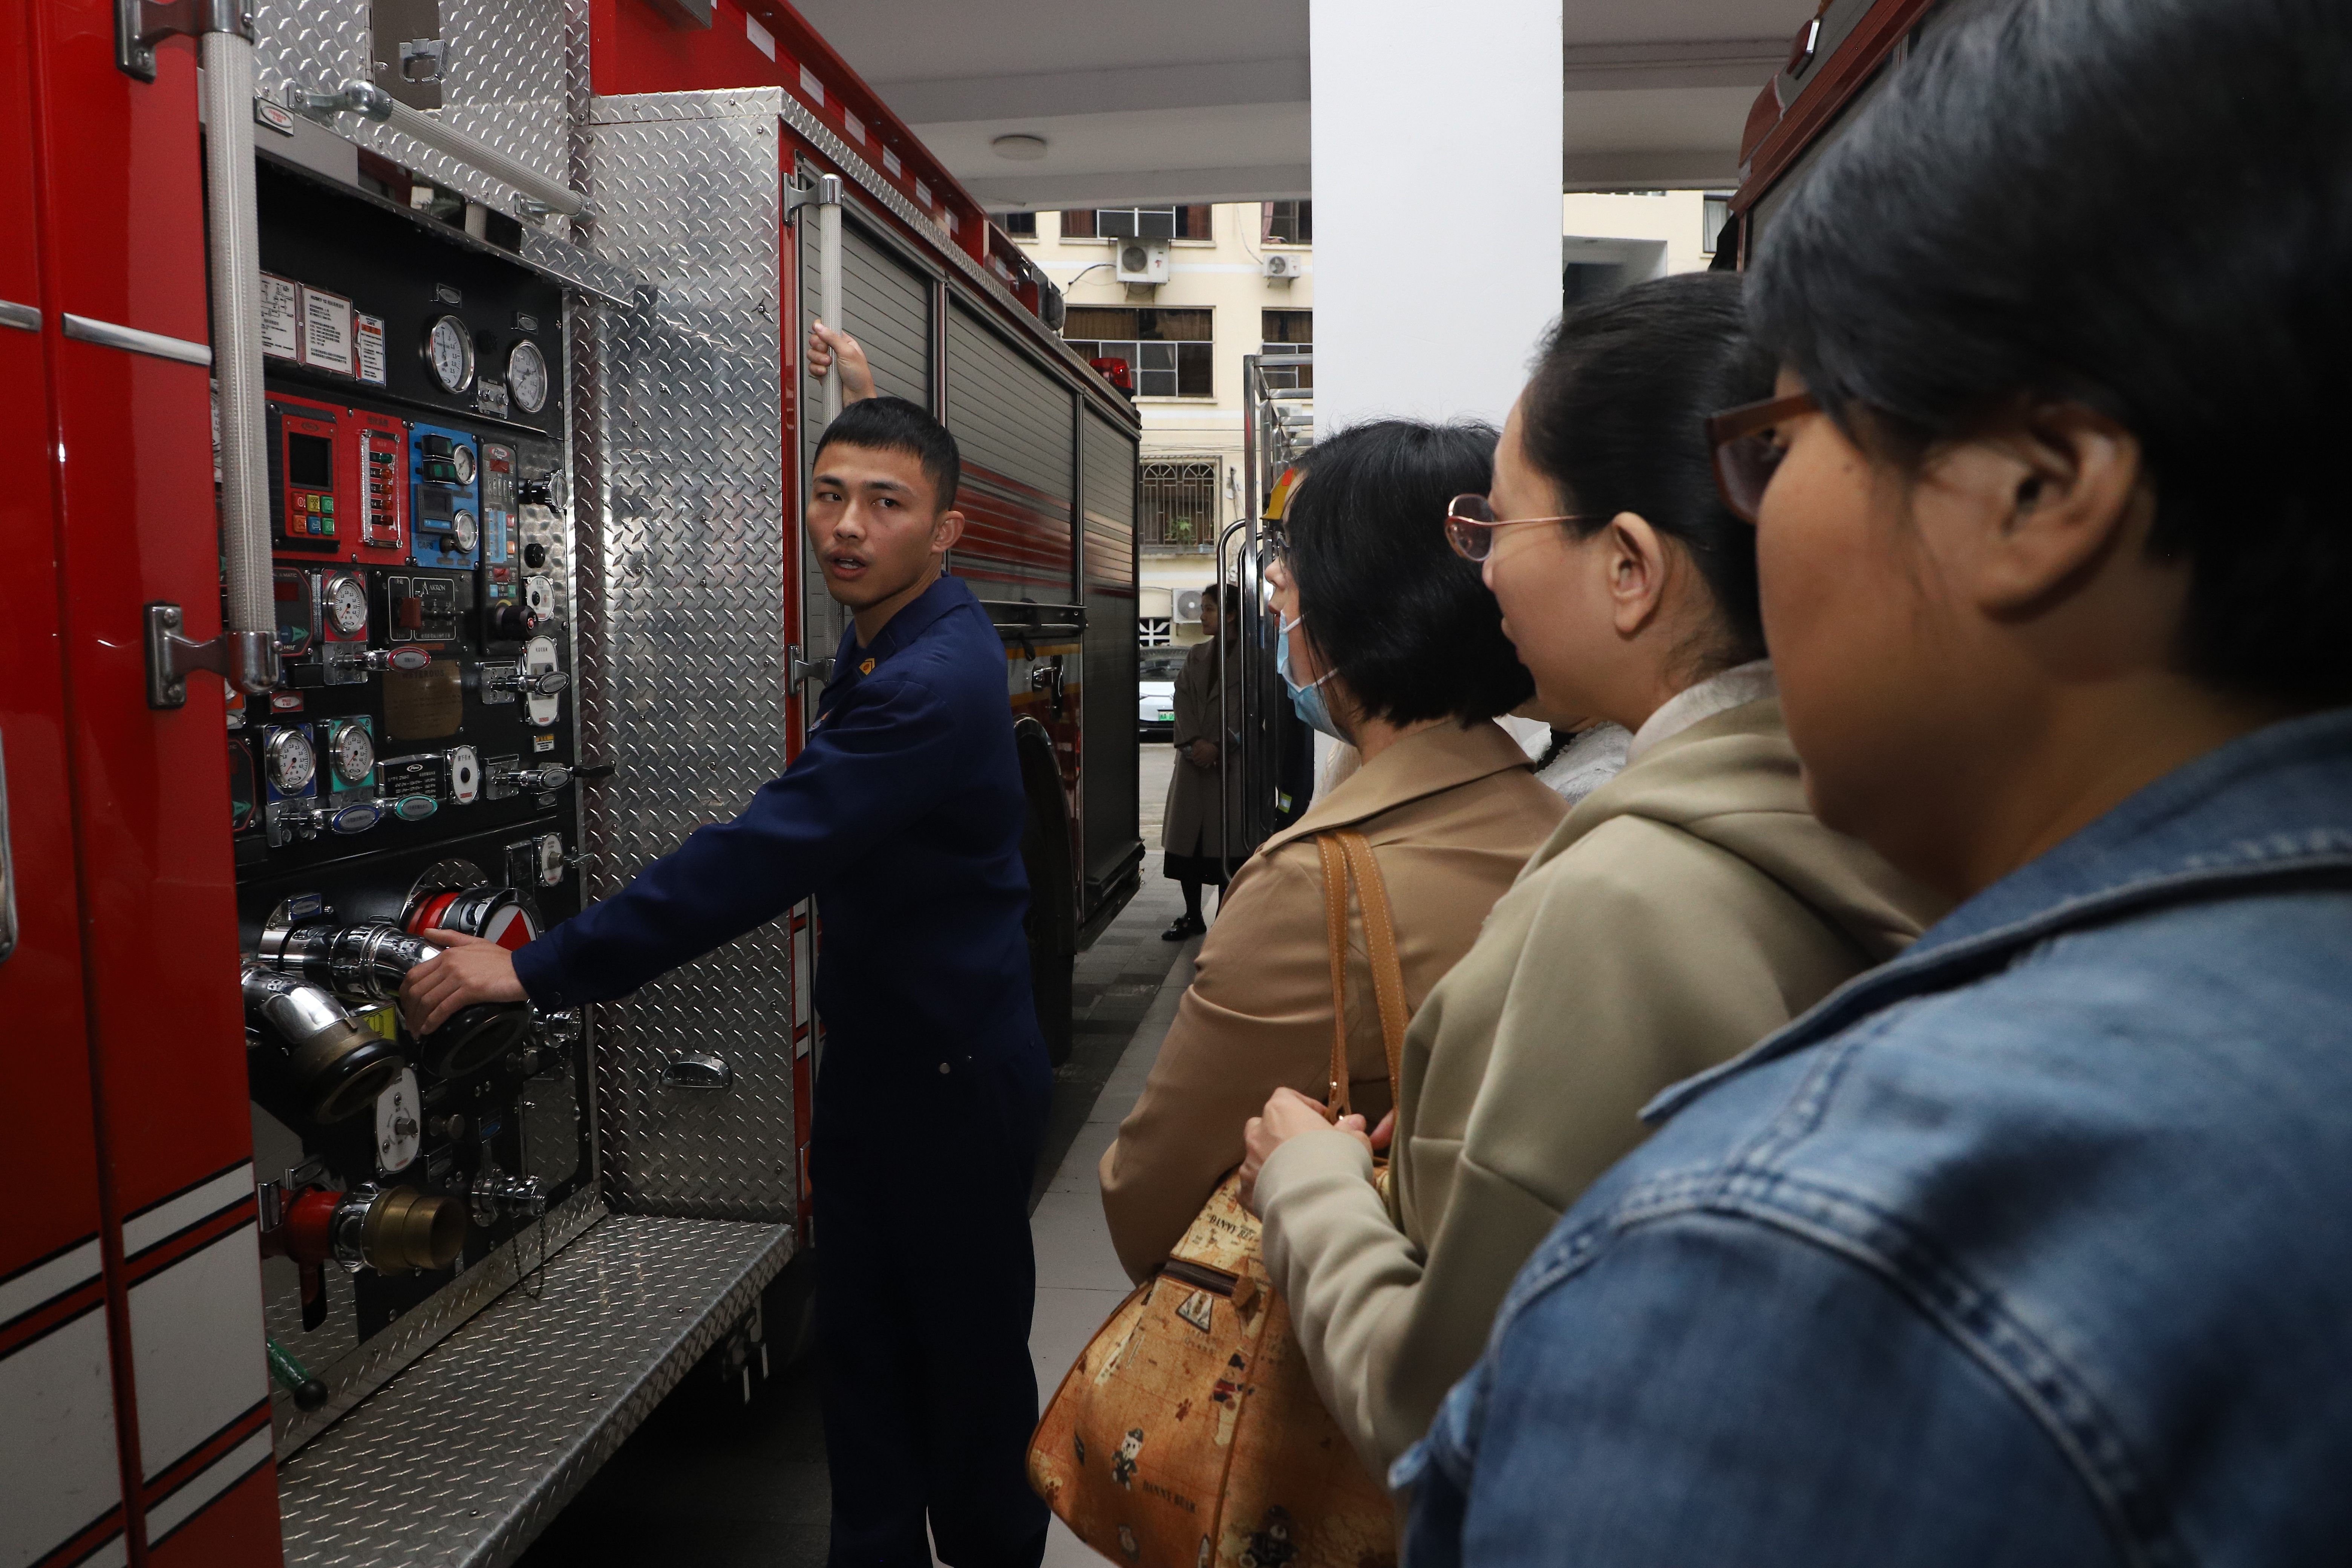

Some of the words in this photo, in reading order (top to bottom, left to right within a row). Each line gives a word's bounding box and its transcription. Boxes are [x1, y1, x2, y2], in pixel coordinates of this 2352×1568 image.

[418, 541, 434, 549] CAFS
[1210, 1214, 1237, 1235] DANNY
[1143, 1479, 1171, 1501] DANNY
[1173, 1494, 1196, 1514] BEAR
